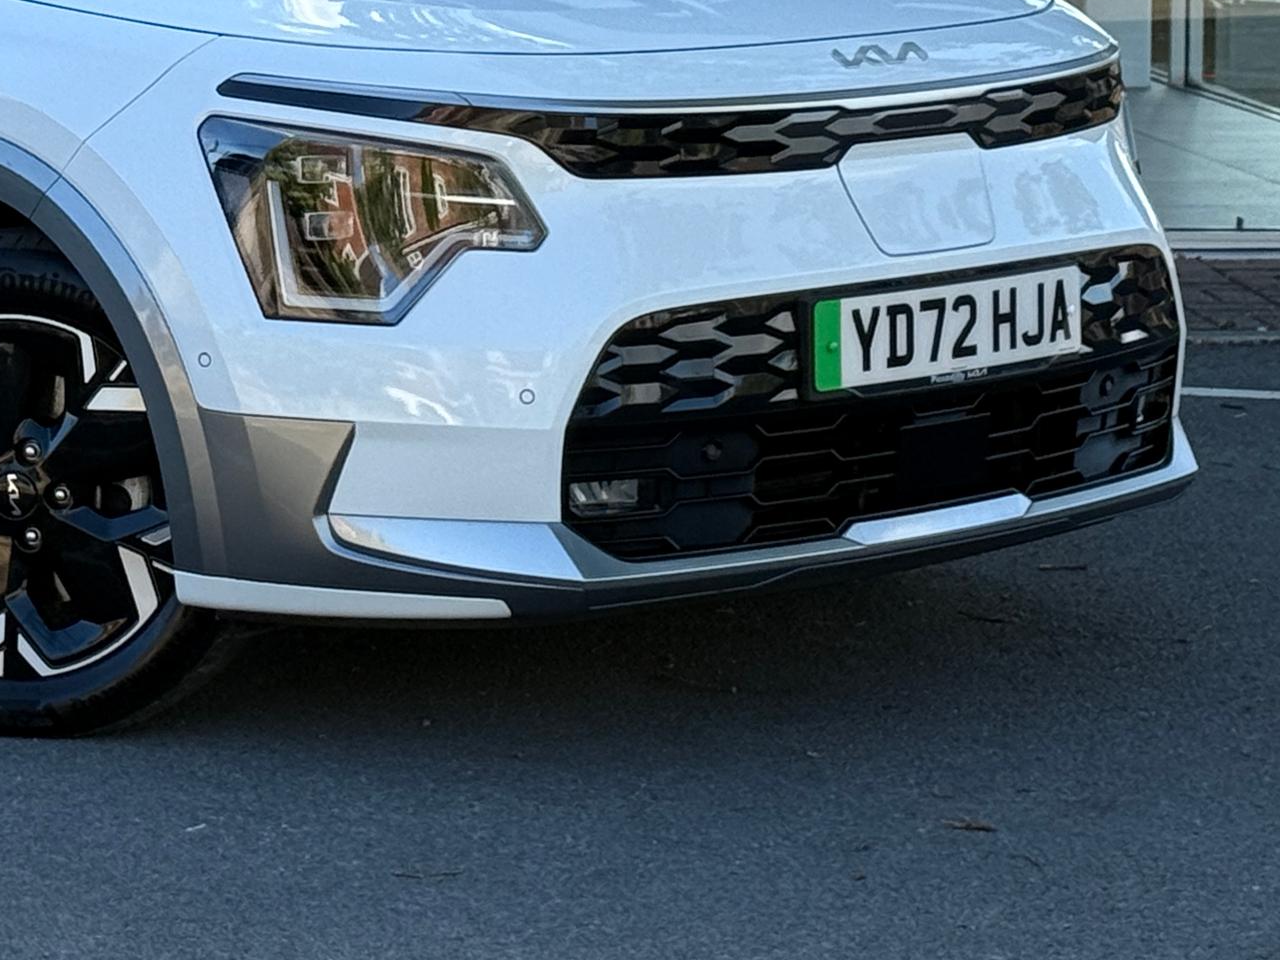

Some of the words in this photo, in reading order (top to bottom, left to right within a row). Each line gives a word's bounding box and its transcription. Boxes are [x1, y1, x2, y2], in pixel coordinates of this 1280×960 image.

[831, 41, 929, 69] KIA
[851, 294, 978, 373] YD72
[992, 279, 1072, 353] HJA
